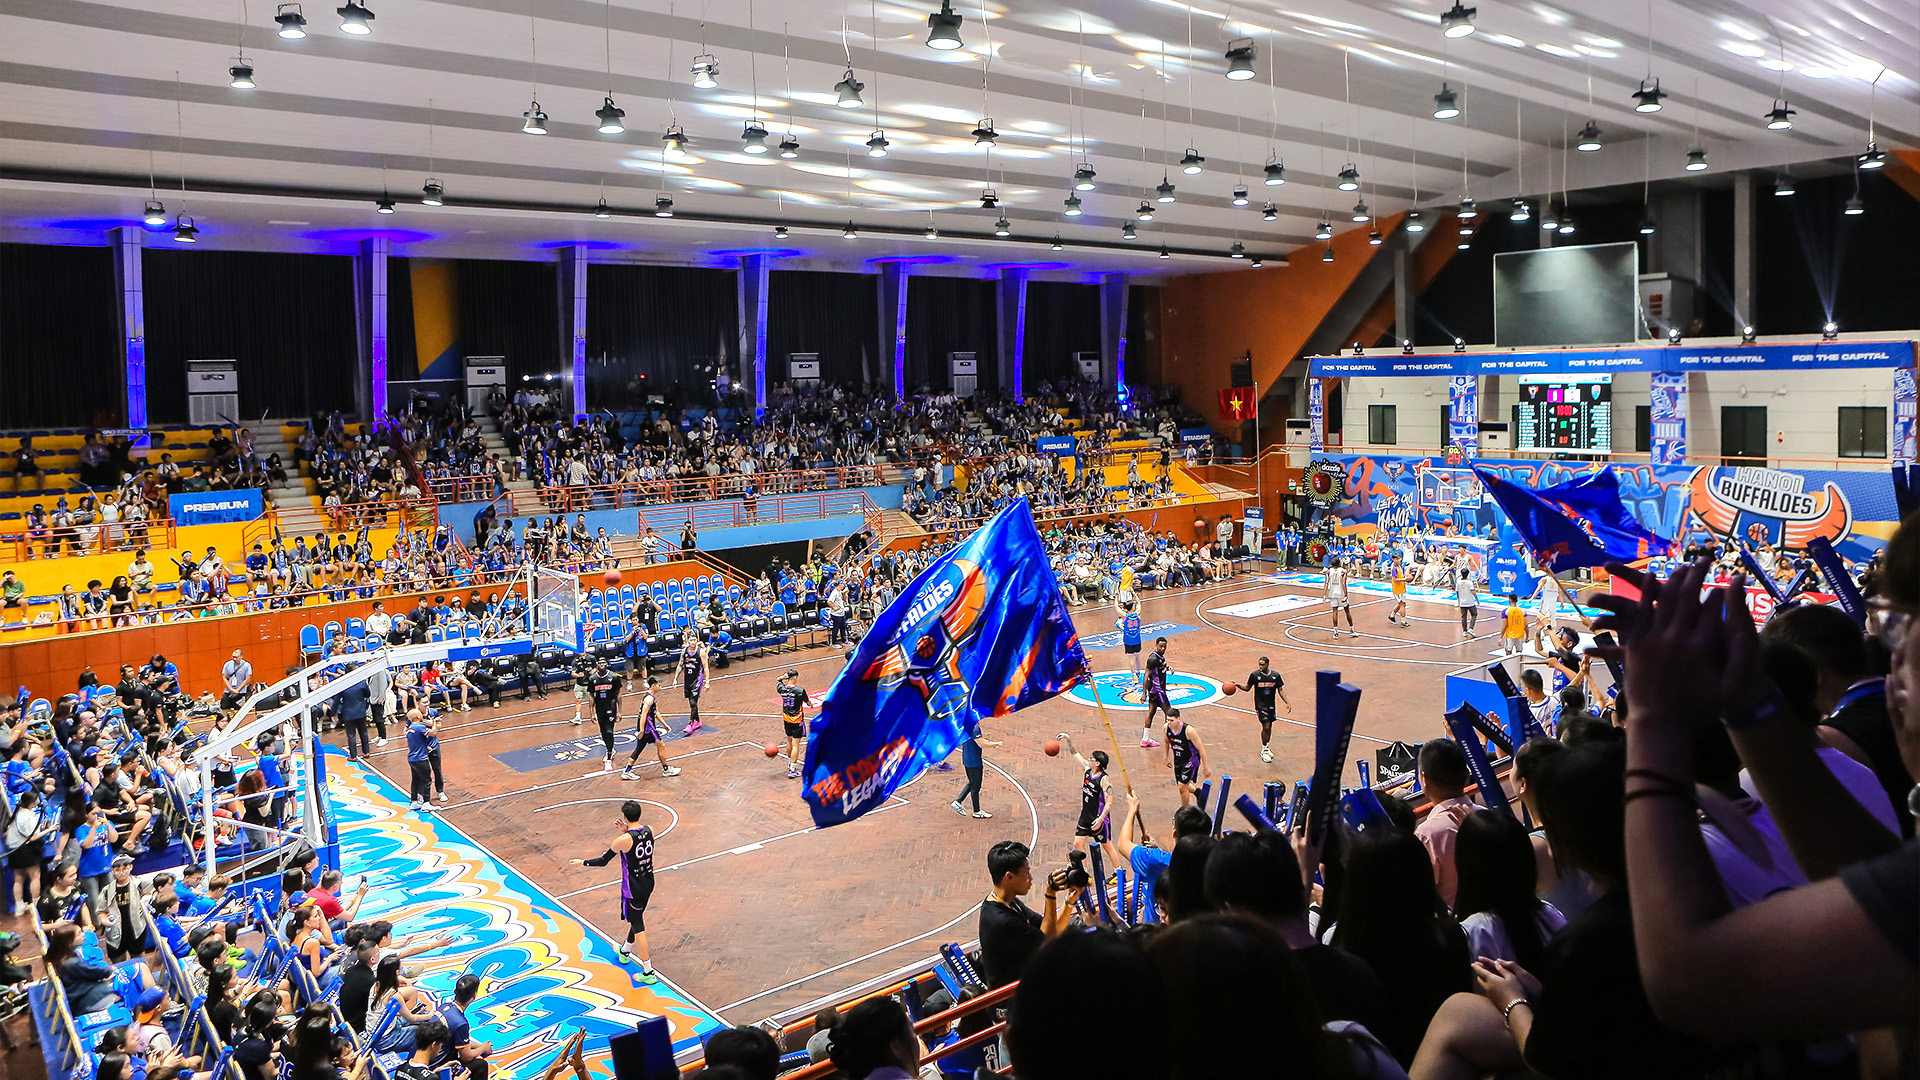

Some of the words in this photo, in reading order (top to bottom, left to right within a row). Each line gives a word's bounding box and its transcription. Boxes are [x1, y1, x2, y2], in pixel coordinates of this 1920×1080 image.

[1723, 356, 1766, 364] CAPITAL
[1841, 352, 1890, 360] CAPITAL
[1043, 442, 1070, 450] PREMIUM
[1446, 454, 1461, 464] 24
[1737, 466, 1802, 494] HANOI
[1721, 480, 1814, 514] BUFFALOES
[183, 500, 249, 513] PREMIUM
[1127, 620, 1138, 628] 24
[812, 772, 849, 807] THE
[636, 840, 653, 858] 68
[950, 955, 964, 972] HANOI
